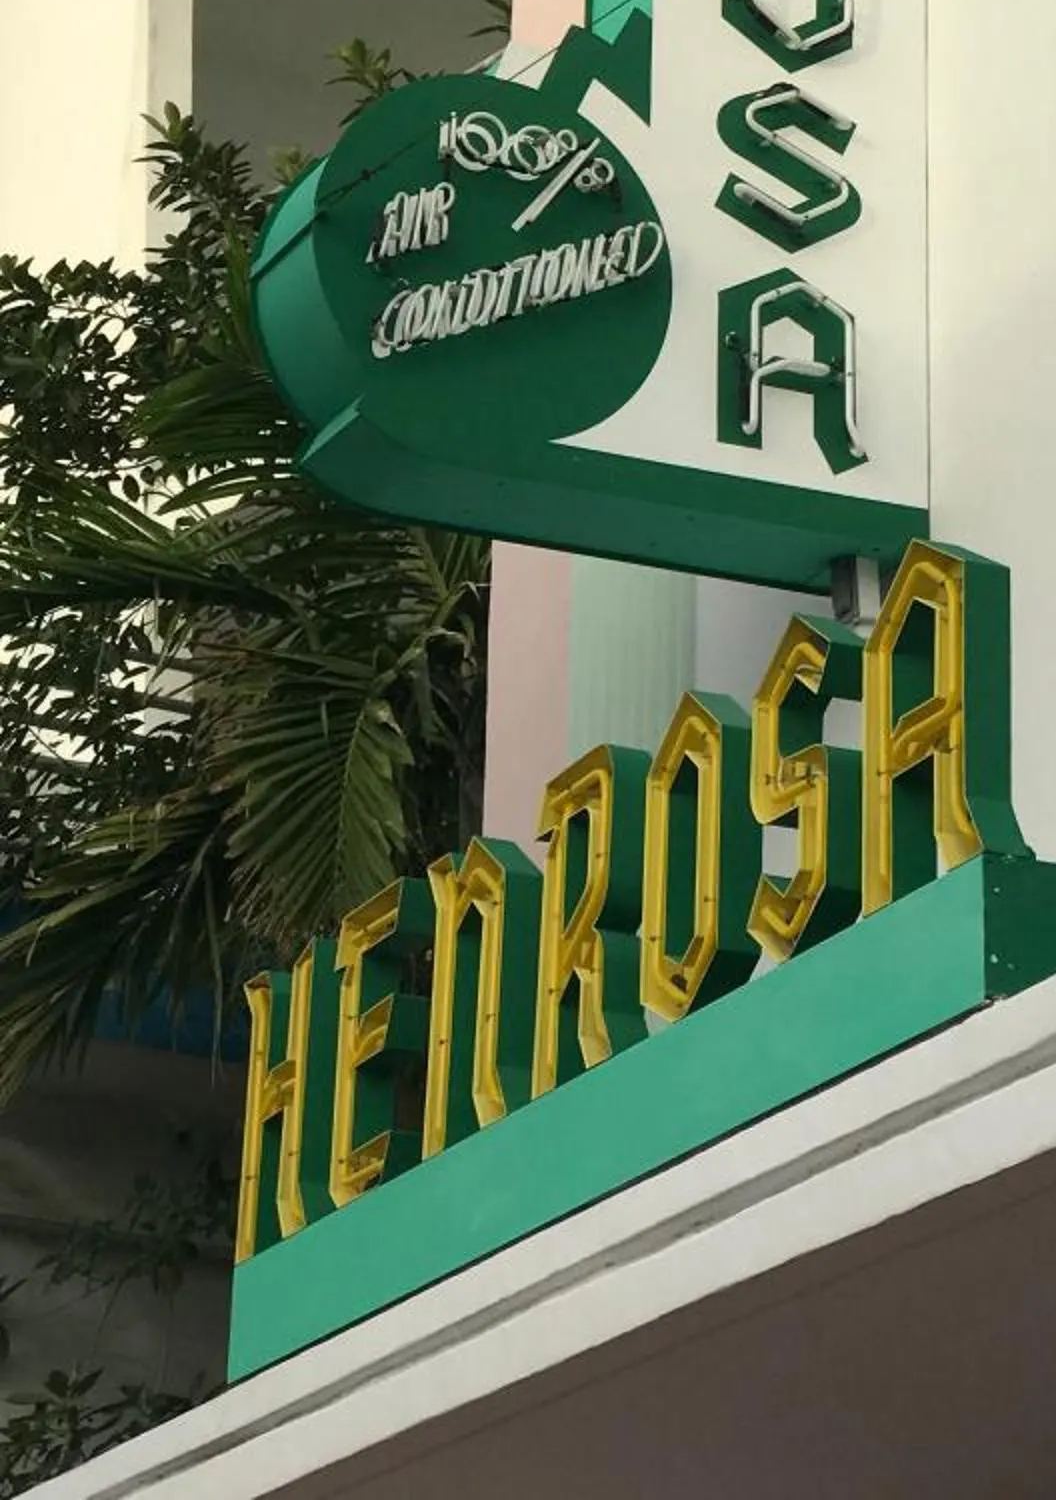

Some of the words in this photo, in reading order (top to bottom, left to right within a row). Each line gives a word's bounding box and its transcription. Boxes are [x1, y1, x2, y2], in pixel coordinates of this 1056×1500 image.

[365, 182, 455, 263] AIR
[438, 111, 615, 231] 100%
[371, 221, 662, 358] CONDITIONED
[236, 540, 983, 1263] HENROSA
